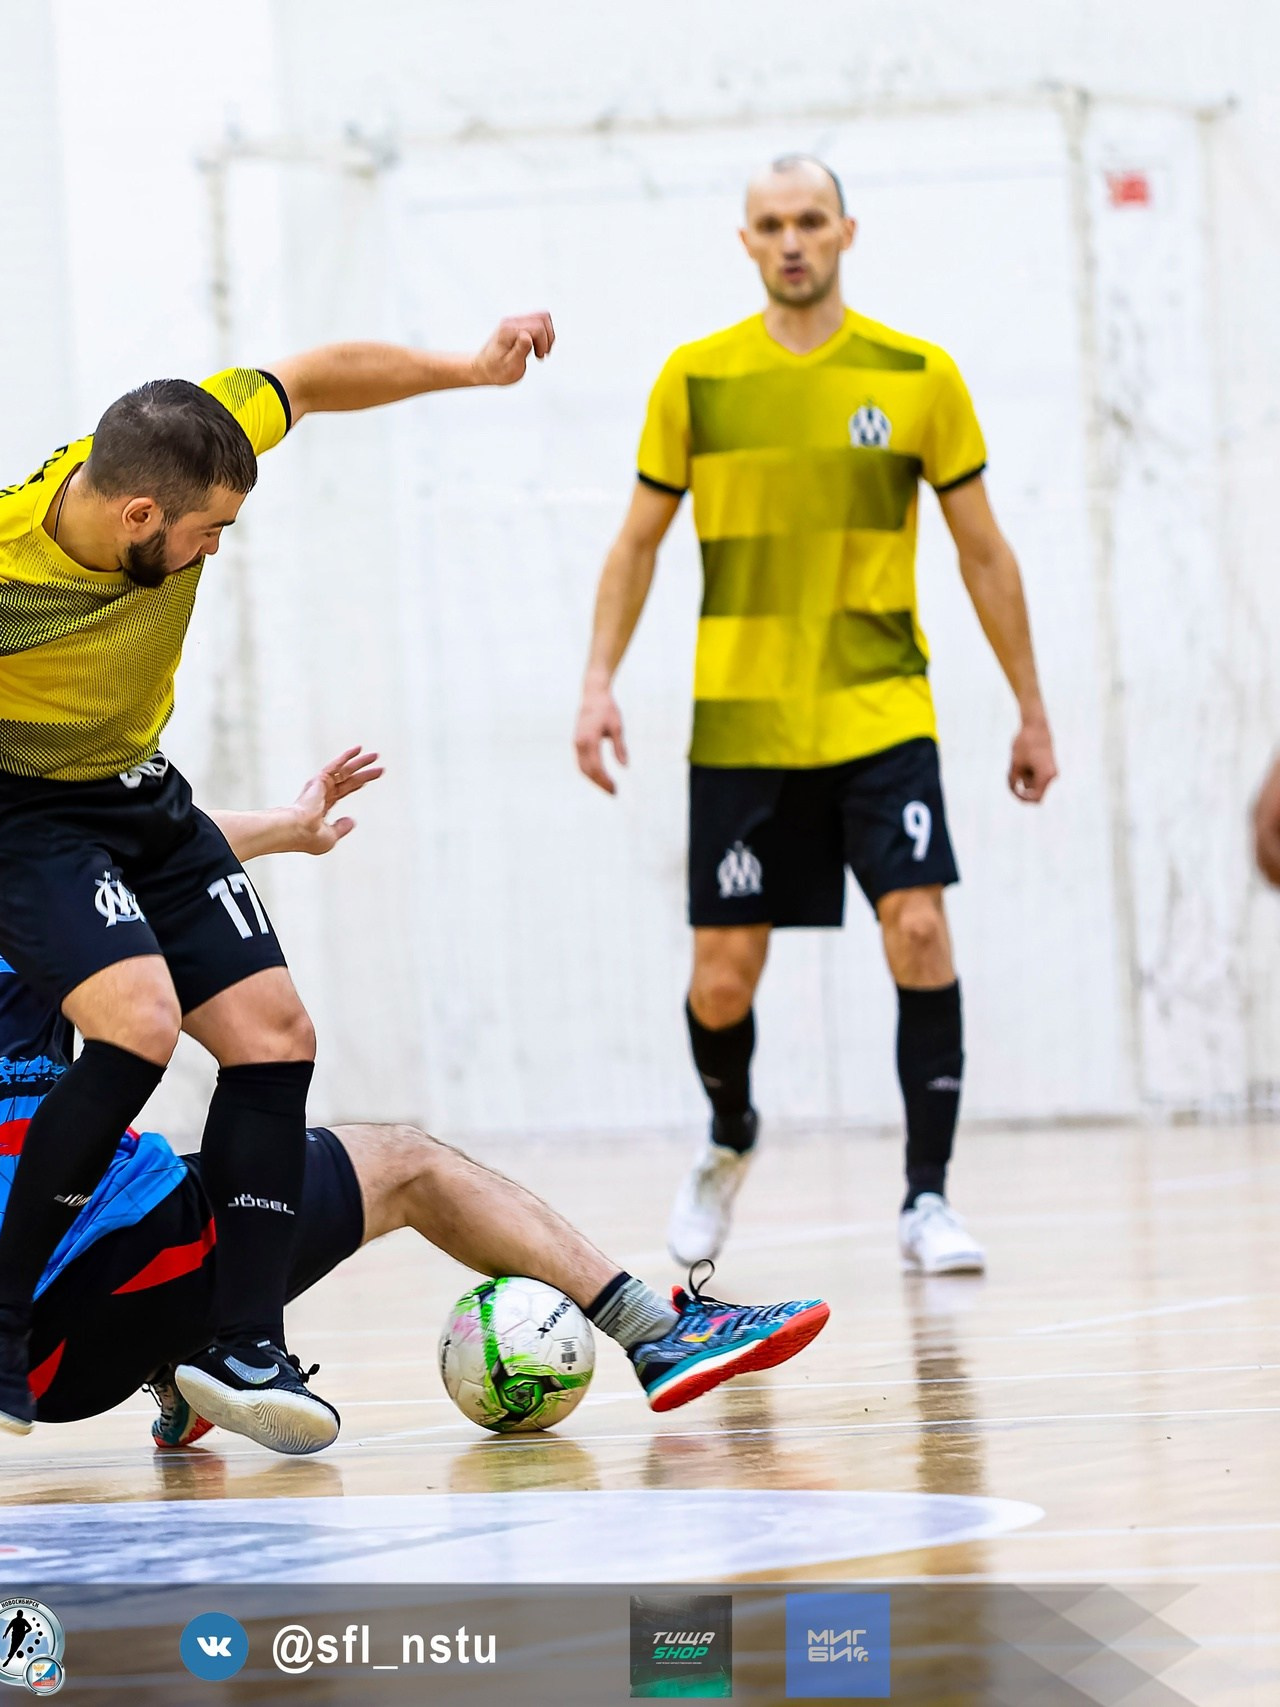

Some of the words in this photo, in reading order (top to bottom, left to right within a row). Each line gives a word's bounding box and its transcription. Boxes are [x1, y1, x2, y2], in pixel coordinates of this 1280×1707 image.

[901, 800, 932, 861] 9
[206, 872, 270, 940] 17
[227, 1193, 296, 1216] JÖGEL
